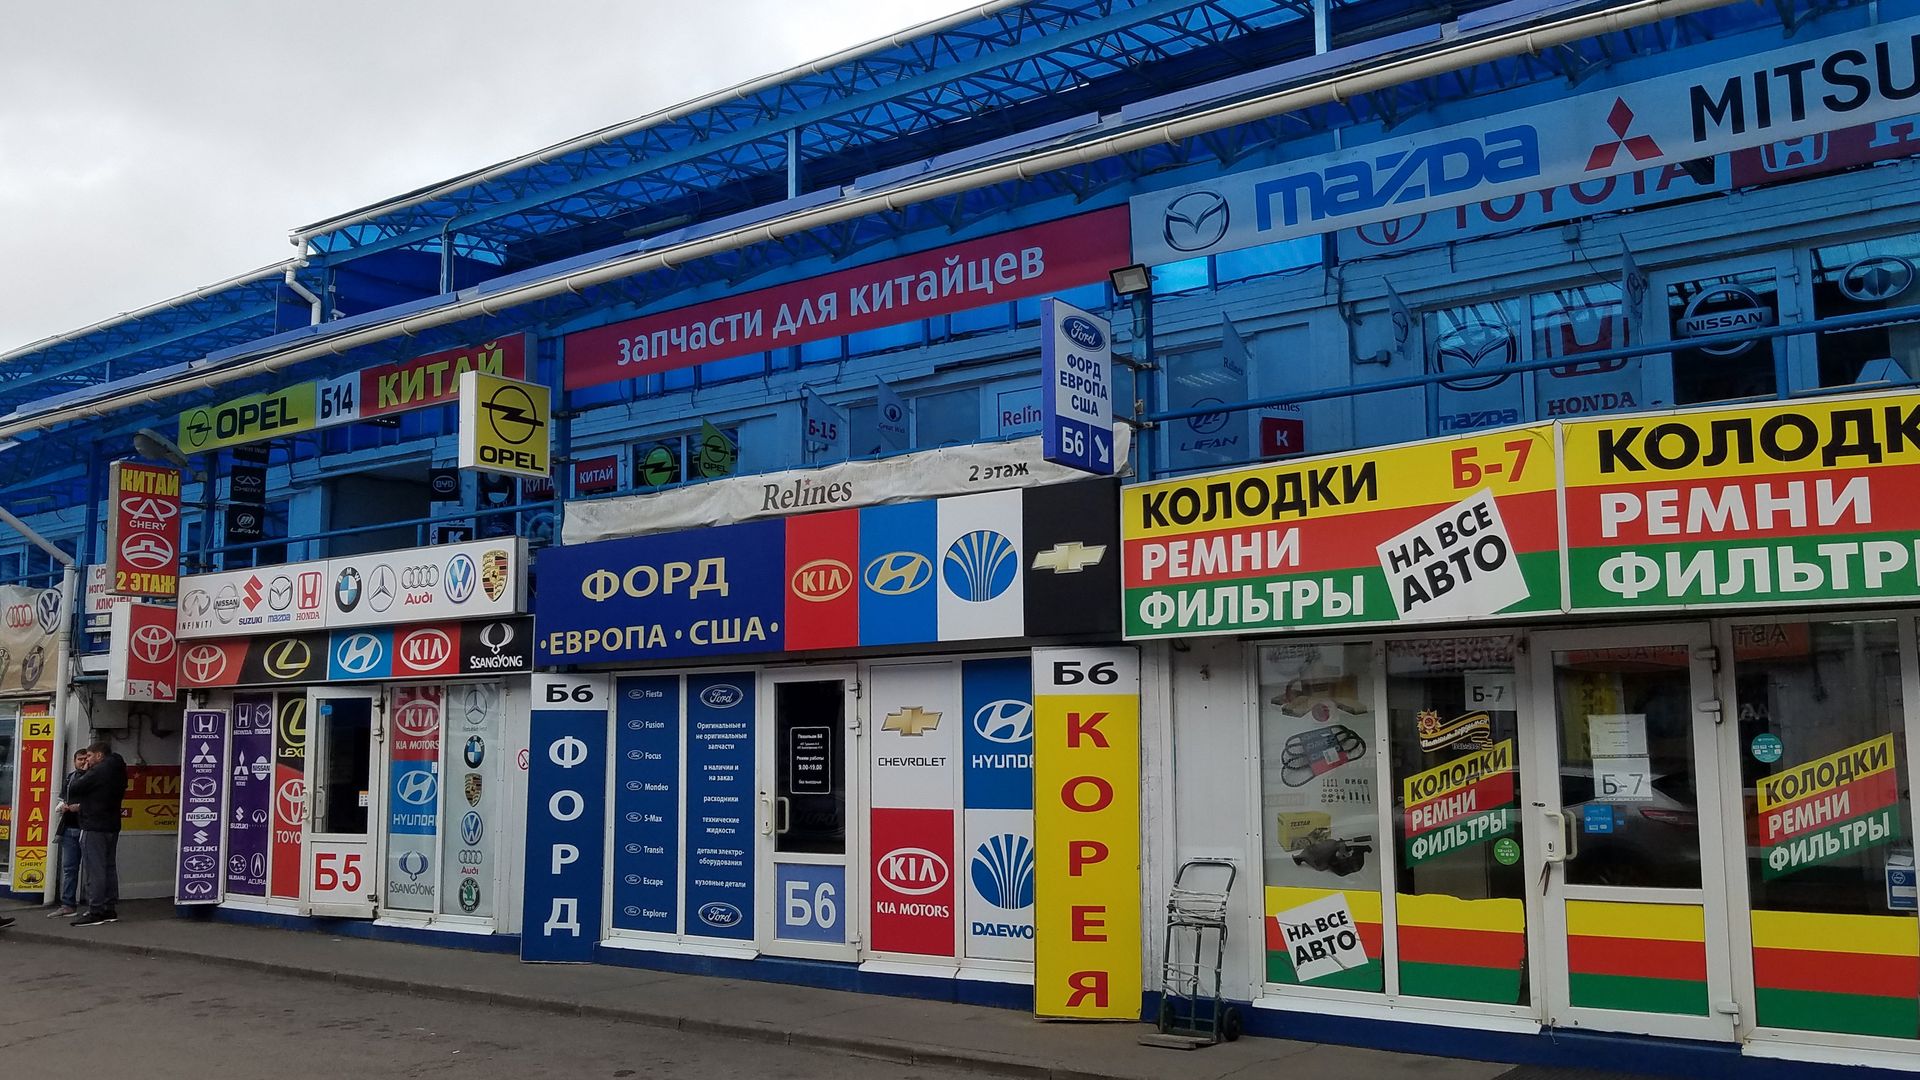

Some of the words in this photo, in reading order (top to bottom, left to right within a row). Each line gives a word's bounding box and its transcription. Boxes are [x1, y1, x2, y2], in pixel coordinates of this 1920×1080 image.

[1689, 34, 1920, 142] MITSU
[772, 291, 838, 340] для
[850, 244, 1046, 316] китайцев
[1685, 310, 1764, 332] NISSAN
[1071, 320, 1096, 346] Ford
[1066, 353, 1101, 381] ФОРД
[1060, 370, 1108, 400] ЕВРОПА
[320, 382, 354, 420] Б14
[1071, 394, 1099, 417] США
[1547, 391, 1637, 417] HONDA
[216, 396, 298, 439] OPEL
[808, 419, 837, 441] Б-15
[1062, 426, 1084, 457] Б6
[1181, 436, 1238, 451] LIFAN
[479, 445, 544, 471] OPEL
[703, 462, 728, 473] OPEL
[1451, 439, 1533, 490] Б-7
[120, 469, 180, 497] КИТАЙ
[579, 465, 614, 484] КИТАЙ
[968, 464, 979, 482] 2
[983, 461, 1029, 480] этаж
[435, 480, 454, 488] BYD
[761, 478, 853, 511] Relines
[1142, 460, 1379, 529] КОЛОДКИ
[1600, 476, 1872, 539] РЕМНИ
[129, 519, 167, 531] CHERY
[1387, 535, 1432, 574] НА
[1435, 502, 1493, 550] ВСЕ
[1142, 528, 1300, 580] РЕМНИ
[581, 556, 729, 602] ФОРД
[801, 569, 843, 592] KIA
[1403, 534, 1507, 614] АВТО
[1599, 539, 1920, 599] ФИЛЬТР
[116, 572, 127, 591] 2
[131, 572, 176, 594] ЭТАЖ
[215, 598, 238, 607] NISSAN
[404, 592, 433, 605] Audi
[1140, 576, 1364, 629] ФИЛЬТРЫ
[178, 620, 212, 630] INFINITI
[238, 617, 263, 625] SUZUKI
[296, 612, 320, 621] HONDA
[549, 623, 667, 656] ЕВРОПА
[689, 619, 766, 645] США
[409, 638, 443, 661] KIA
[1053, 661, 1119, 685] Б6
[545, 683, 594, 703] Б6
[645, 690, 663, 698] Fiesta
[709, 689, 733, 703] Ford
[1472, 685, 1505, 703] Б-7
[29, 723, 52, 736] Б4
[404, 709, 435, 728] KIA
[645, 721, 664, 729] Fusion
[696, 722, 741, 730] Оригинальные
[395, 740, 408, 750] KIA
[408, 740, 440, 750] MOTORS
[645, 752, 662, 760] Focus
[878, 757, 947, 767] CHEVROLET
[1411, 747, 1507, 802] КОЛОДКИ
[1602, 774, 1644, 795] Б-7
[1765, 742, 1888, 806] КОЛОДКИ
[27, 747, 48, 842] КИТАЙ
[644, 783, 669, 791] Mondeo
[644, 814, 663, 823] S-Max
[702, 816, 740, 824] технические
[1412, 788, 1477, 832] РЕМНИ
[1768, 790, 1850, 840] РЕМНИ
[543, 735, 588, 937] ФОРД
[1412, 808, 1507, 860] ФИЛЬТРЫ
[1768, 812, 1890, 872] ФИЛЬТРЫ
[643, 845, 664, 854] Transit
[696, 847, 718, 855] детали
[1060, 712, 1114, 1008] КОРЕЯ
[314, 853, 362, 893] Б5
[461, 866, 479, 875] Audi
[699, 858, 743, 867] оборудования
[889, 856, 938, 882] KIA
[643, 877, 664, 887] Escape
[695, 879, 724, 887] кузовные
[724, 880, 747, 888] детали
[642, 909, 668, 918] Explorer
[708, 906, 732, 922] Ford
[785, 880, 837, 929] Б6
[876, 901, 896, 914] KIA
[899, 903, 950, 918] MOTORS
[972, 921, 1034, 940] DAEWO
[1287, 922, 1315, 942] НА
[1314, 910, 1349, 932] ВСЕ
[1294, 930, 1357, 966] АВТО
